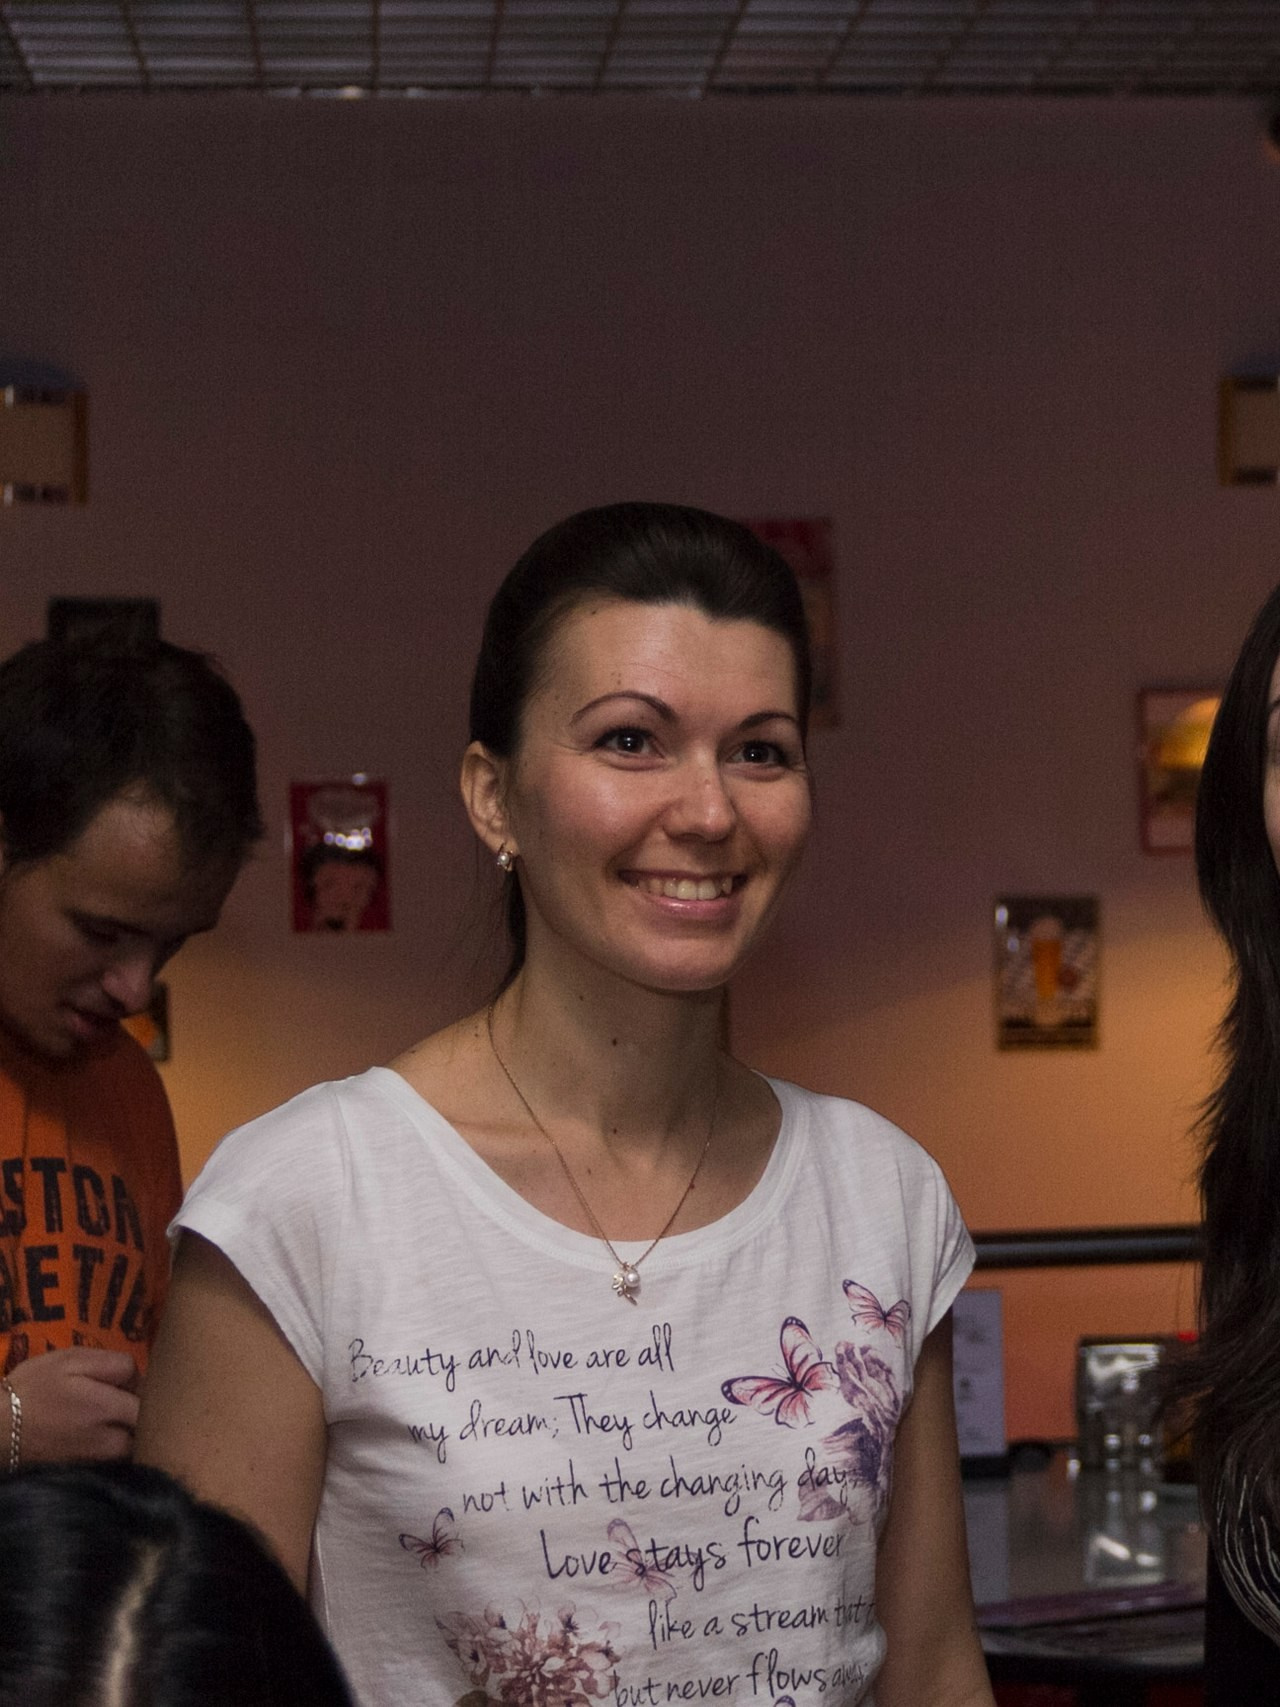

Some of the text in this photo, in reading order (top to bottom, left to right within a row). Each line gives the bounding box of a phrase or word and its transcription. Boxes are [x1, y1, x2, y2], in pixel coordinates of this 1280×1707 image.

[348, 1322, 675, 1392] Beauty and love are all
[407, 1389, 738, 1464] my dream; They change
[462, 1481, 513, 1513] not
[522, 1458, 588, 1509] with
[598, 1456, 651, 1503] the
[659, 1454, 788, 1516] changing
[539, 1515, 846, 1593] Love stays forever
[648, 1598, 696, 1651] like
[703, 1616, 724, 1636] a
[730, 1602, 828, 1637] stream
[612, 1669, 663, 1707] but
[666, 1673, 741, 1701] never
[745, 1647, 828, 1698] flows
